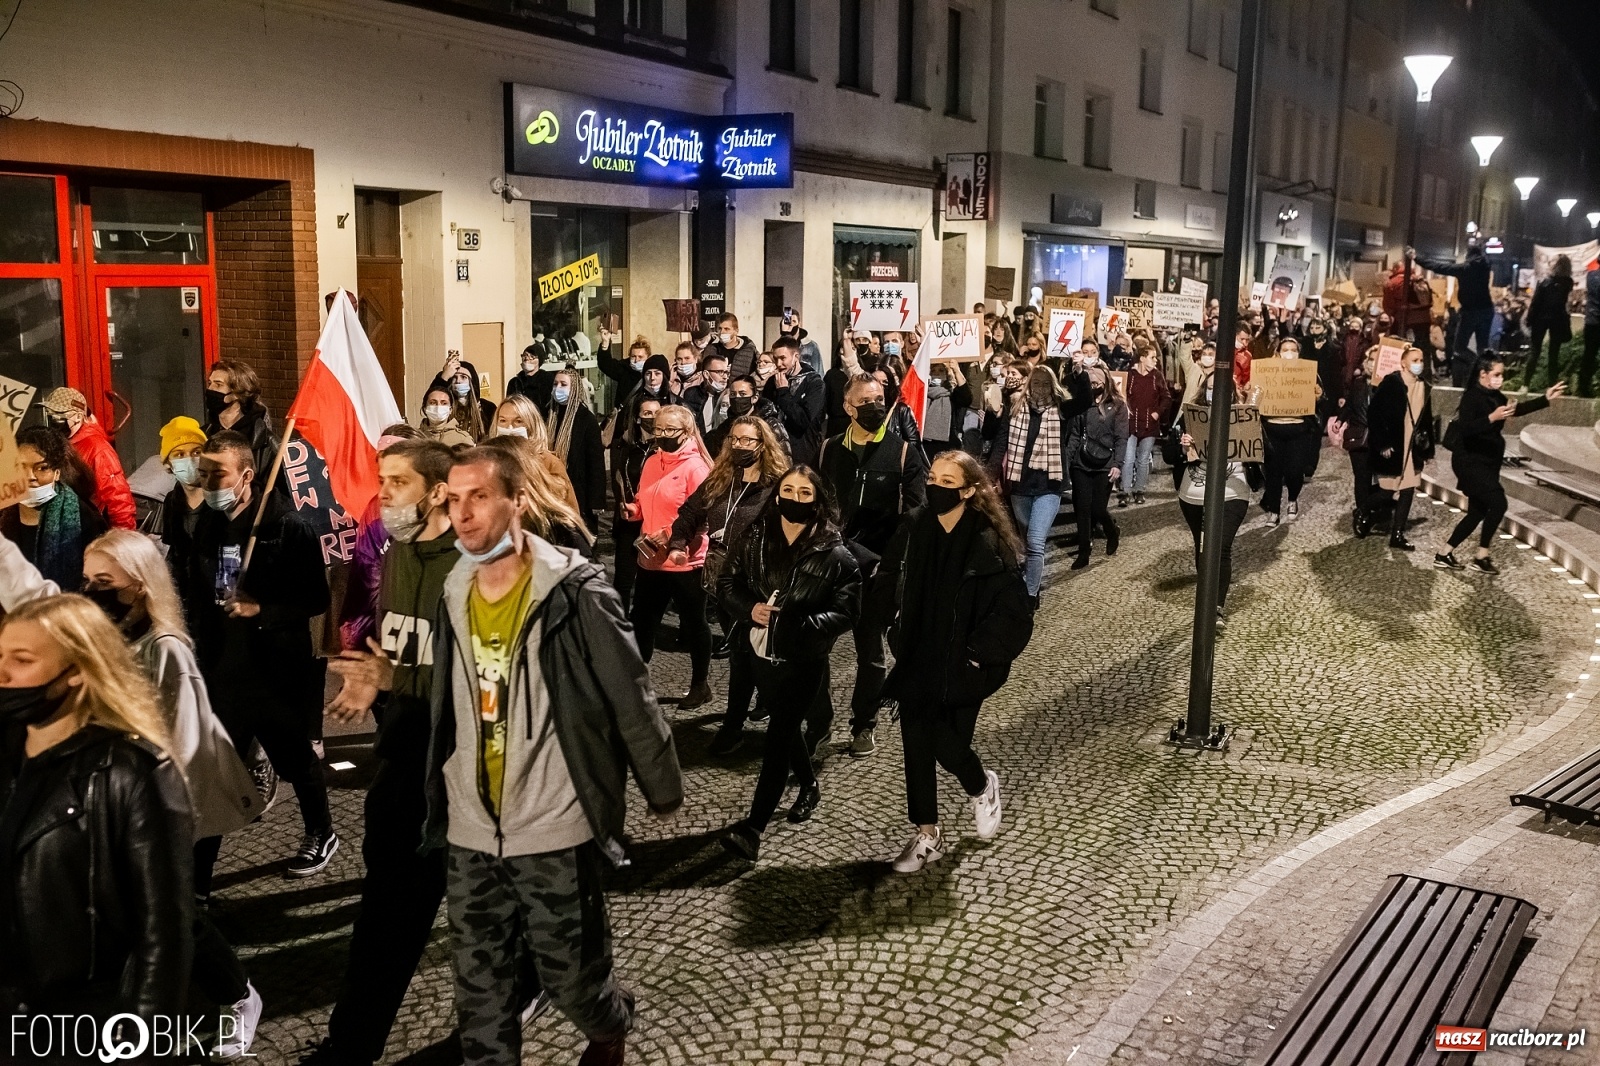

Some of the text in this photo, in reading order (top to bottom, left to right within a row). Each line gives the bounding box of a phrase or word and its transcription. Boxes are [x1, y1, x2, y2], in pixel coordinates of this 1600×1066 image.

[576, 109, 704, 167] Jubiler Złotnik
[721, 127, 777, 155] Jubiler
[592, 155, 636, 173] OCZADŁY
[721, 156, 778, 180] Złotnik
[464, 232, 479, 246] 36
[458, 266, 468, 277] 36
[541, 258, 599, 299] ZŁOTO -10%
[870, 265, 899, 277] PRZECENA
[1046, 297, 1060, 307] JAK
[1115, 297, 1153, 309] MEFEDRO
[929, 319, 978, 346] ABORCJA?
[1187, 407, 1260, 425] TO JEST
[1192, 438, 1263, 460] WJNA
